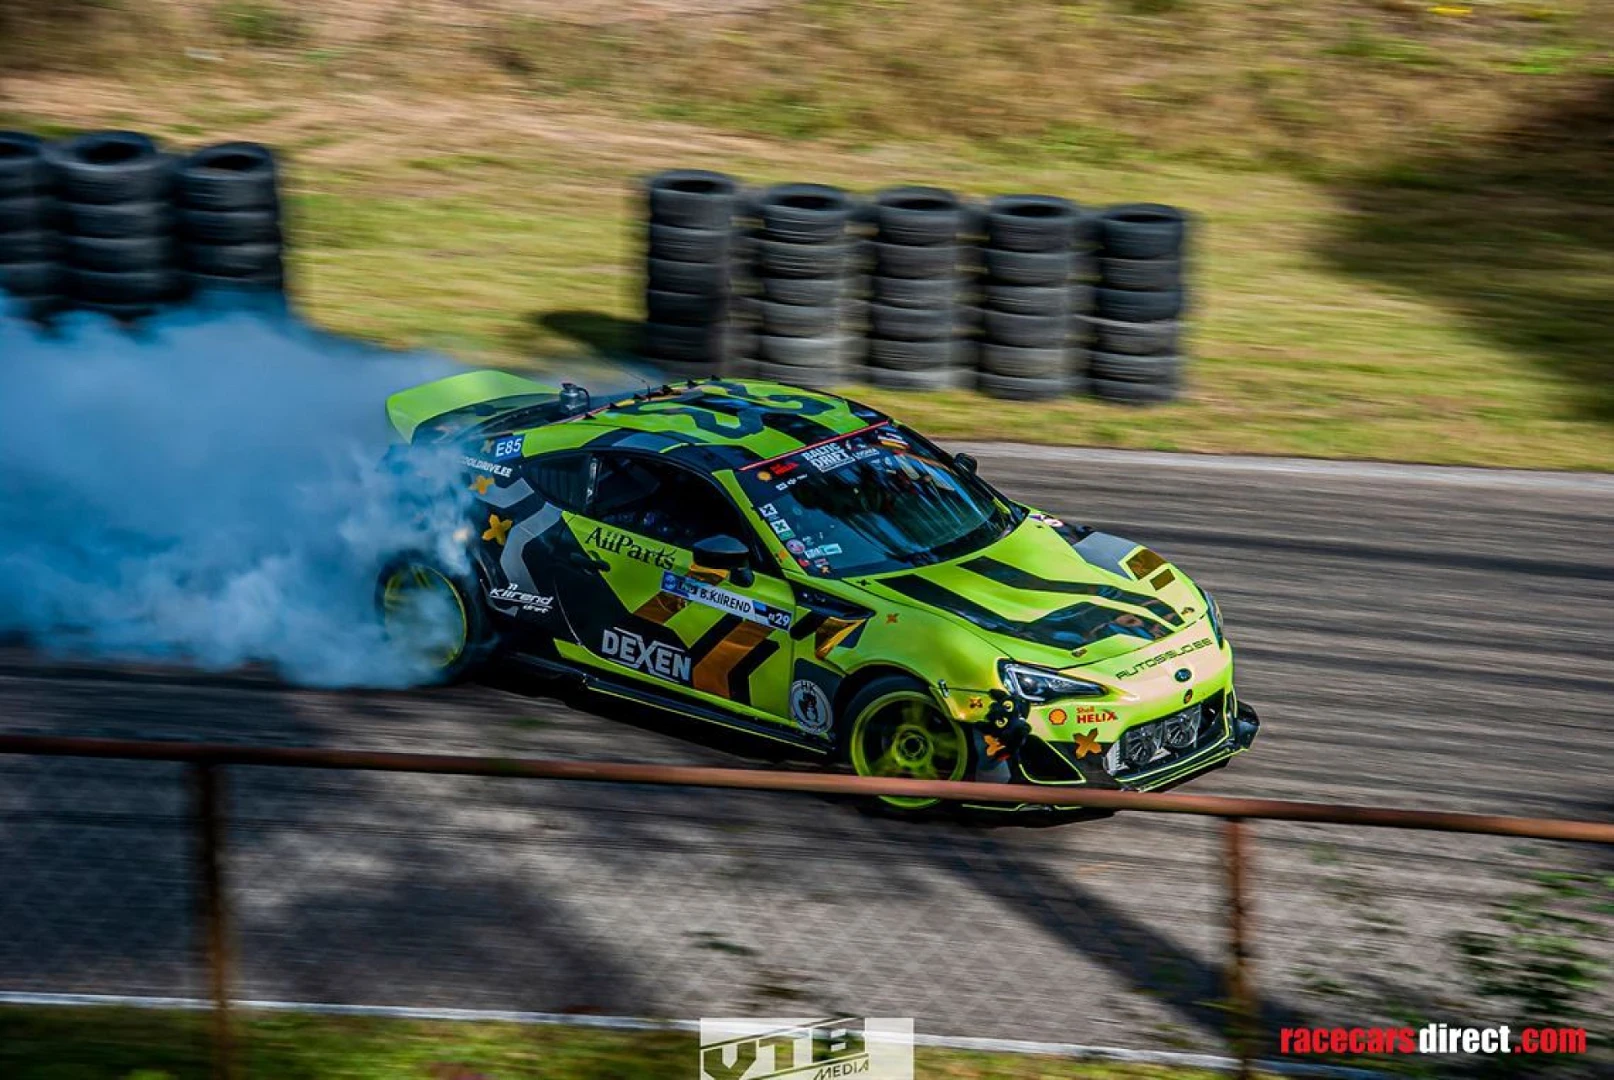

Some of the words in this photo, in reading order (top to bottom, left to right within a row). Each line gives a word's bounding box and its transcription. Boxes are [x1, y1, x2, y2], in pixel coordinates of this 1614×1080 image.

[495, 438, 521, 457] E85
[802, 442, 840, 461] BALTIC
[812, 448, 850, 468] DRIFT
[602, 627, 692, 683] DEXEN
[1076, 709, 1118, 724] HELIX
